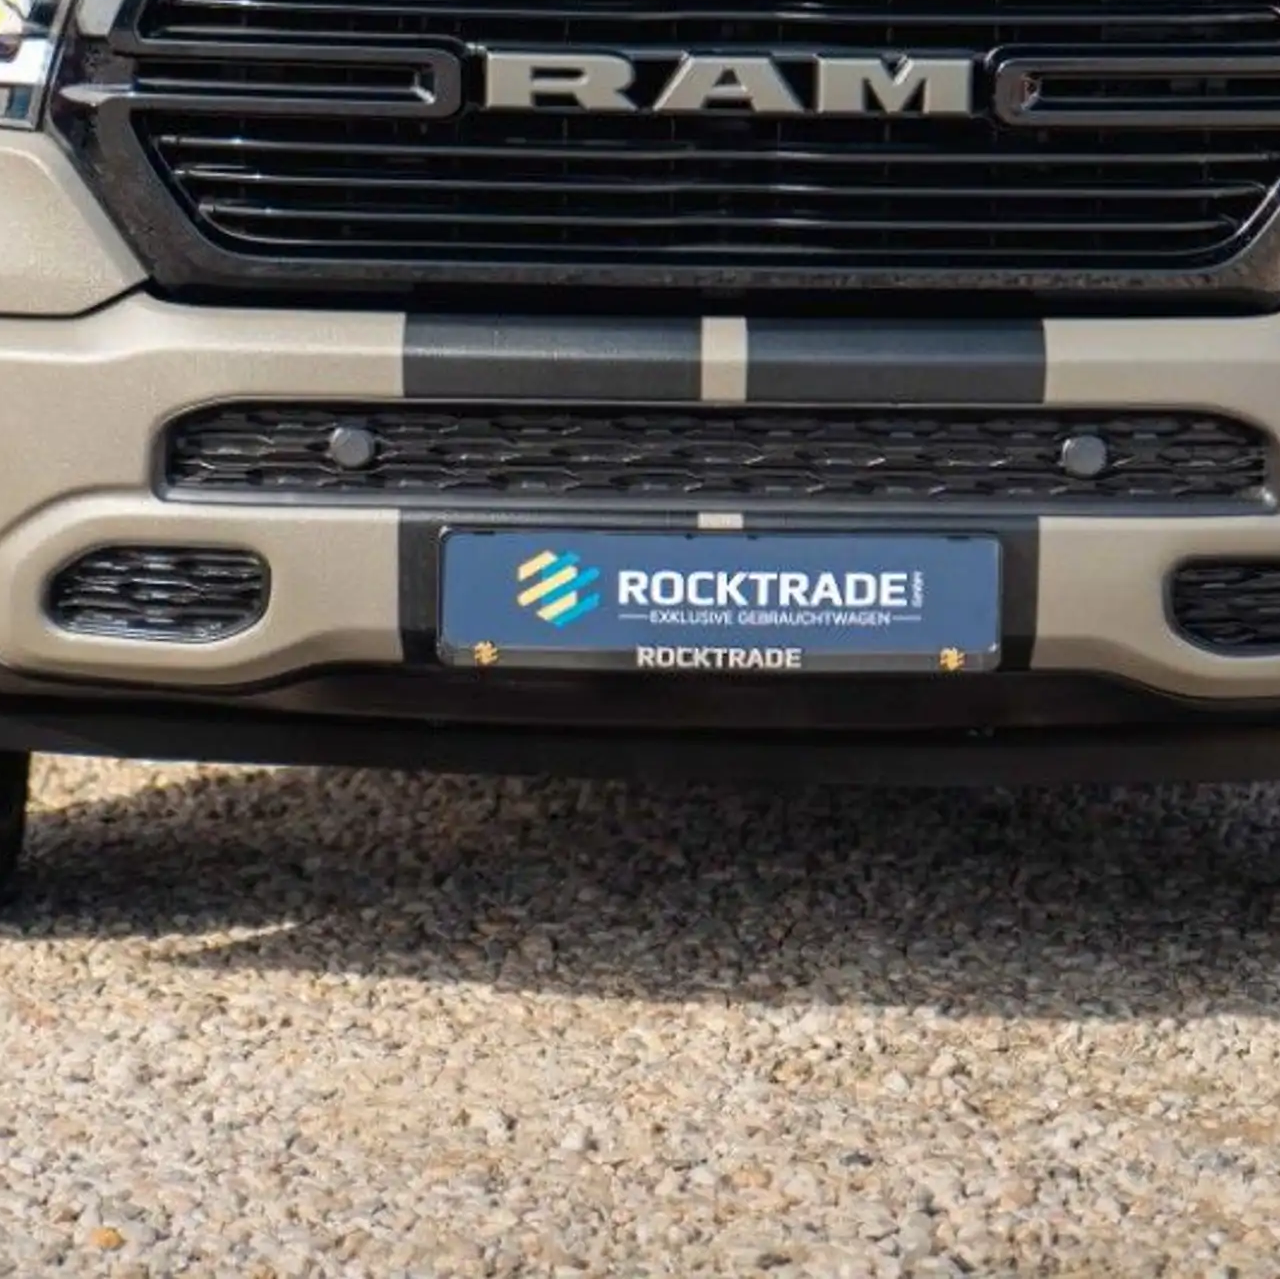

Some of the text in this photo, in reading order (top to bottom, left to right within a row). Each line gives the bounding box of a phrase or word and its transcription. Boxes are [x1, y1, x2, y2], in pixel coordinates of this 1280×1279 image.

[486, 51, 973, 112] RAM
[619, 570, 908, 608] ROCKTRADE
[650, 611, 892, 626] EXKLUSIVE GEBRAUCHTWAGEN
[637, 645, 802, 669] ROCKTRADE
